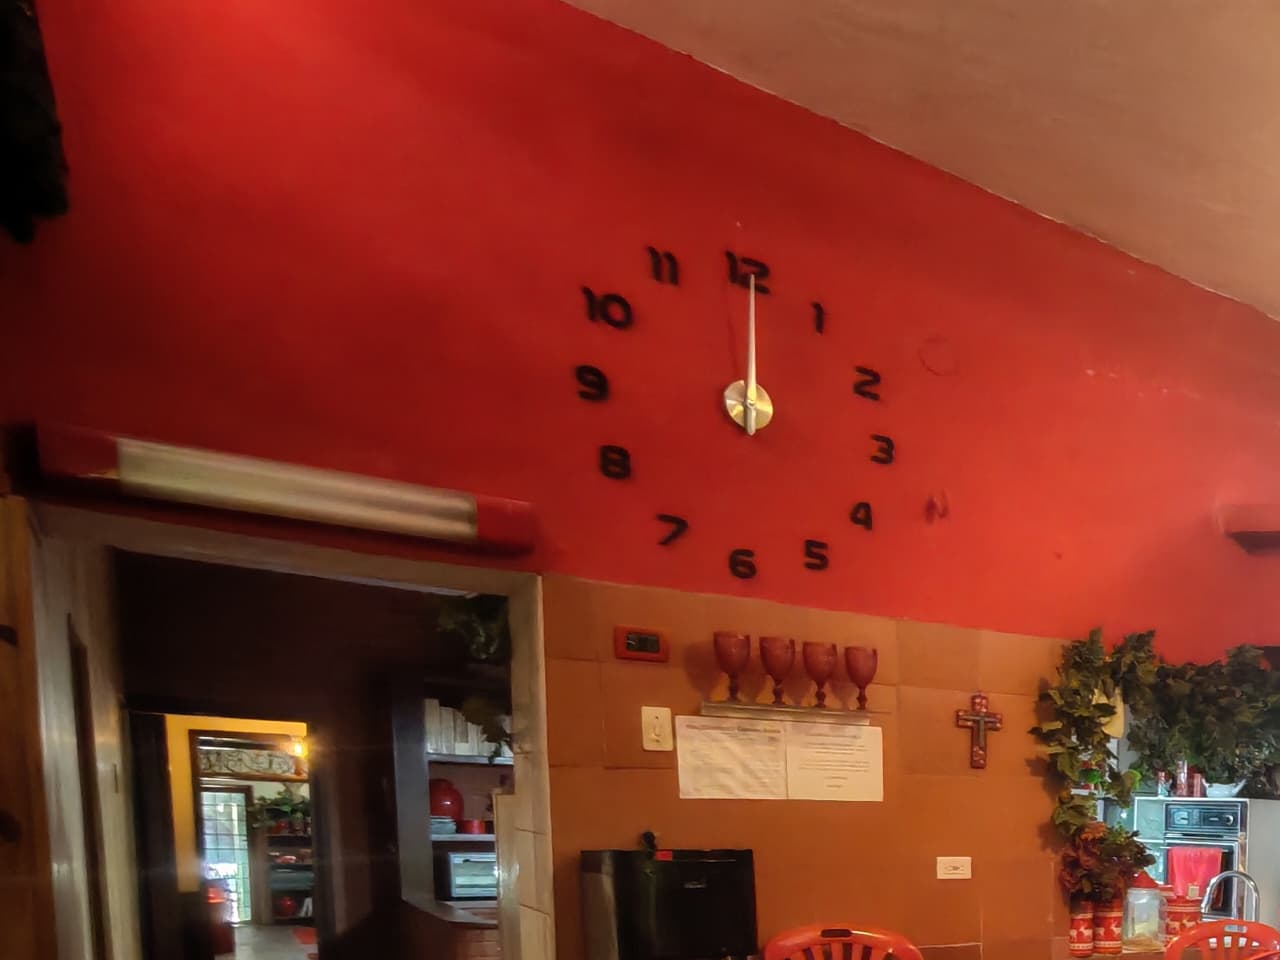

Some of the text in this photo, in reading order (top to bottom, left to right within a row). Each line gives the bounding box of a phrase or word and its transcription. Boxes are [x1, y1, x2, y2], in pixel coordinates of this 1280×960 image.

[647, 246, 679, 285] 11
[725, 250, 770, 295] 12
[581, 285, 633, 330] 10
[811, 301, 825, 334] 1
[575, 364, 609, 402] 9
[853, 366, 881, 401] 2
[599, 444, 631, 480] 8
[870, 434, 895, 465] 3
[656, 513, 688, 545] 7
[850, 501, 873, 531] 4
[728, 548, 757, 579] 6
[803, 539, 829, 570] 5
